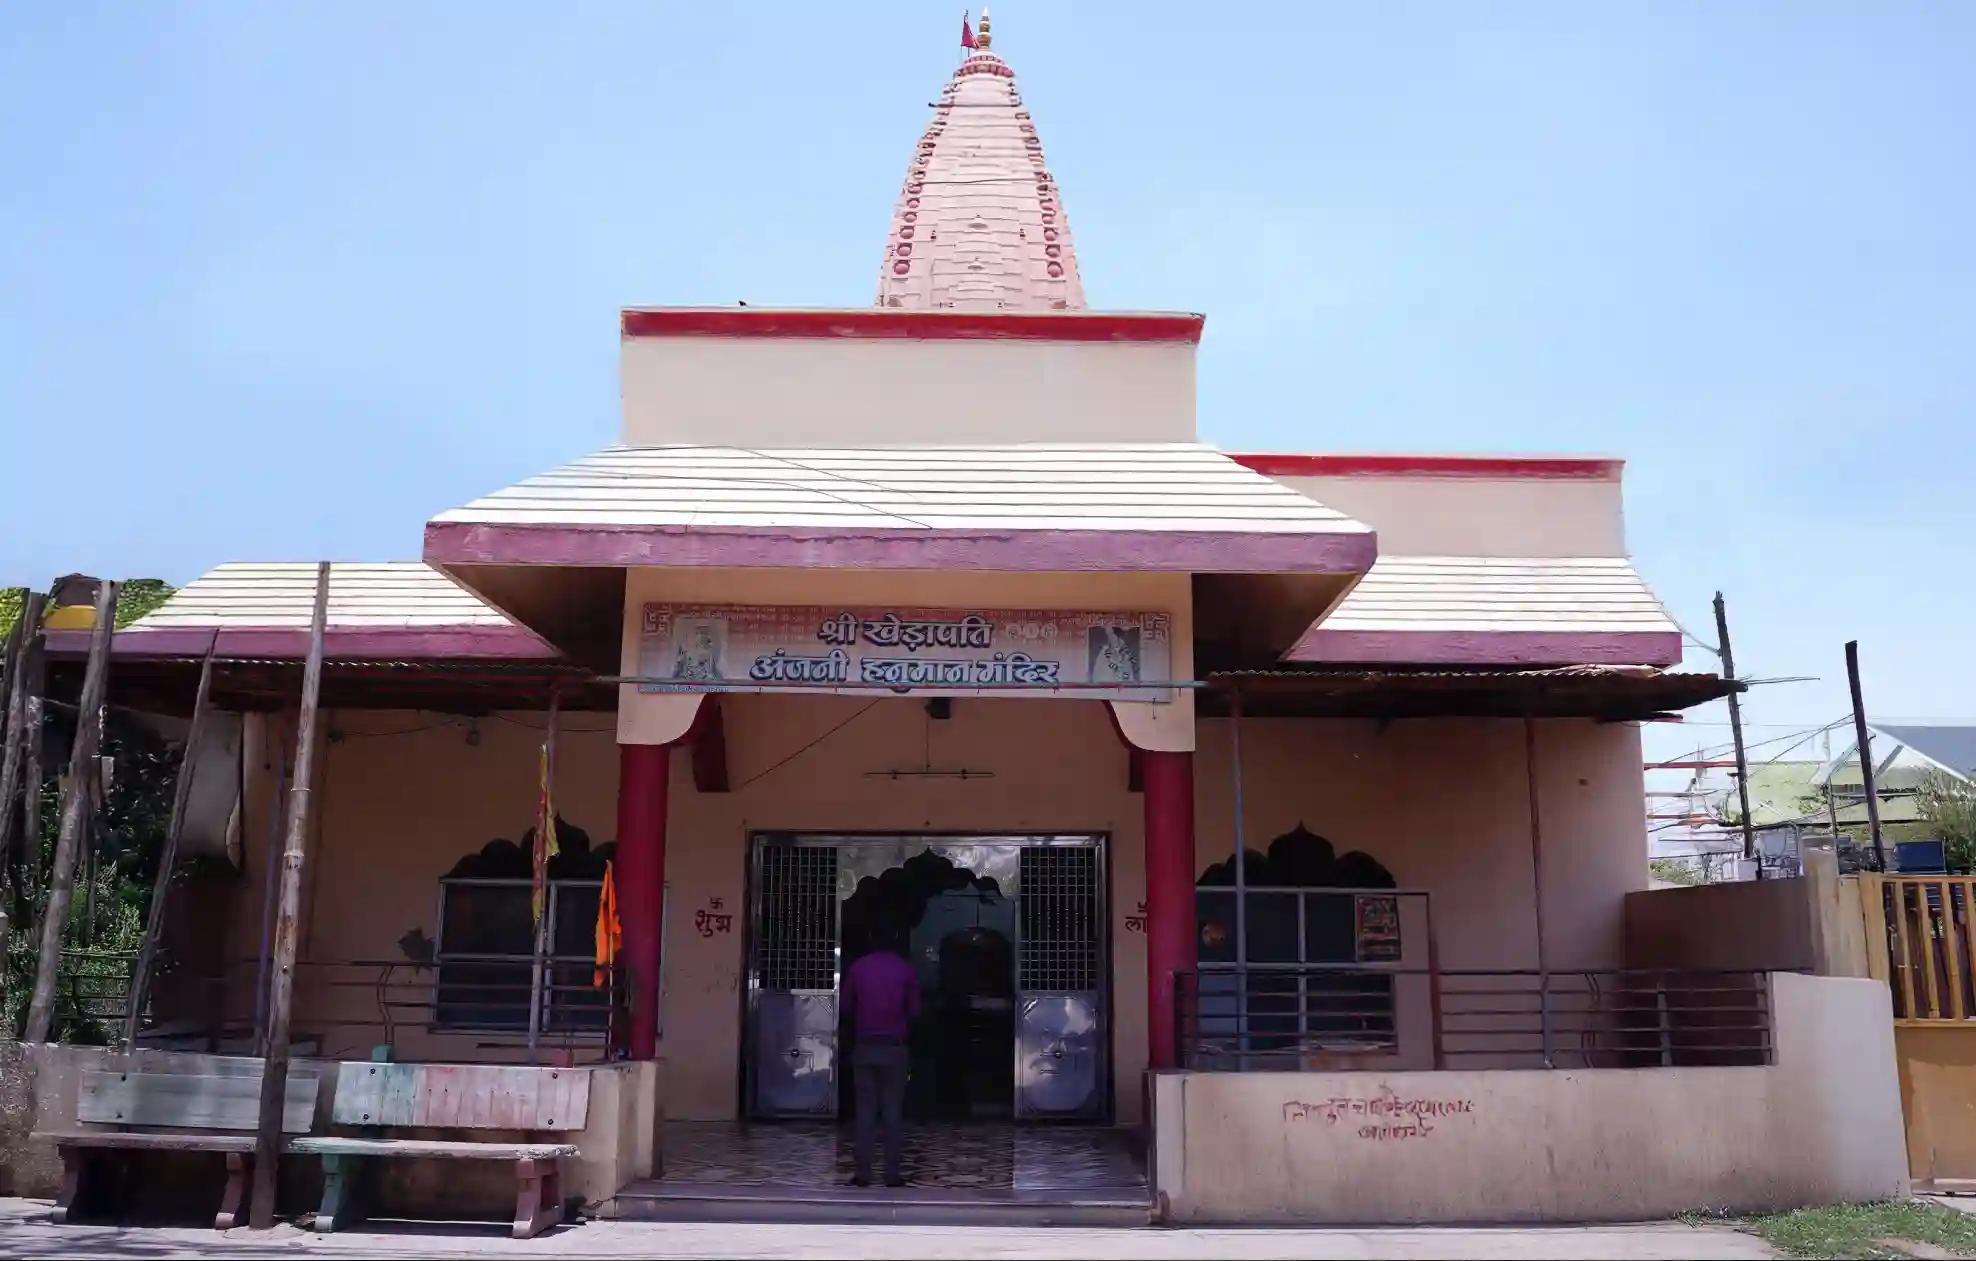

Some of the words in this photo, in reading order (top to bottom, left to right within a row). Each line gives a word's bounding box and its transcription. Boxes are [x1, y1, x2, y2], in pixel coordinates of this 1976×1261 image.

[818, 613, 858, 644] श्री
[863, 614, 993, 651] खेड़ापति
[750, 648, 849, 682] अंजनी
[860, 657, 973, 693] हनुमान
[976, 653, 1060, 684] मंदिर
[695, 910, 732, 938] शुभ
[1125, 916, 1147, 933] ला
